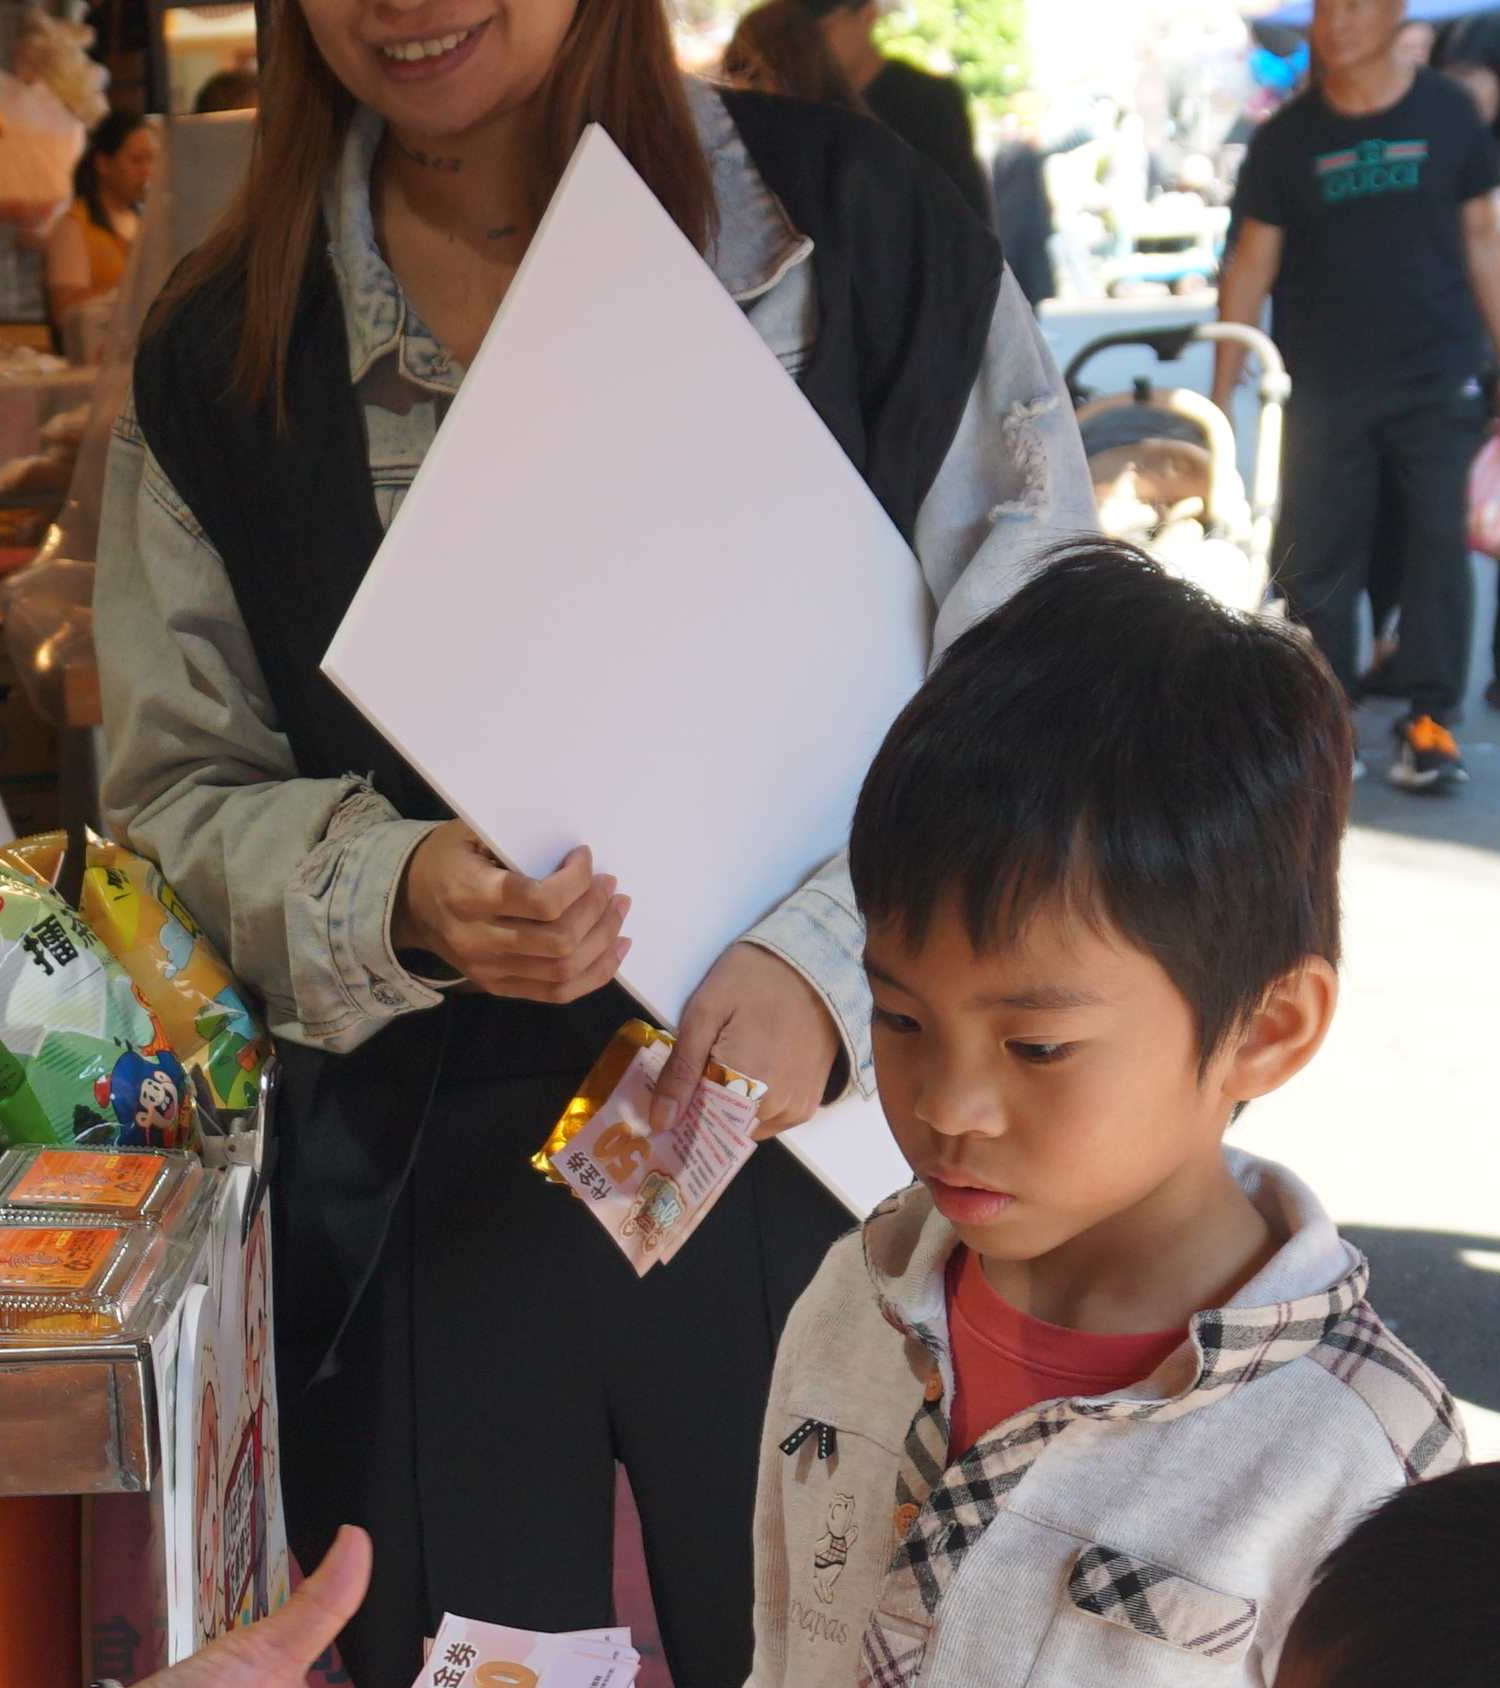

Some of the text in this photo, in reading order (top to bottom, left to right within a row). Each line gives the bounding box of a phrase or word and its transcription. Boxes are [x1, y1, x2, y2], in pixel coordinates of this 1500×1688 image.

[1323, 160, 1420, 202] GUCCI
[566, 1150, 615, 1203] 代金券
